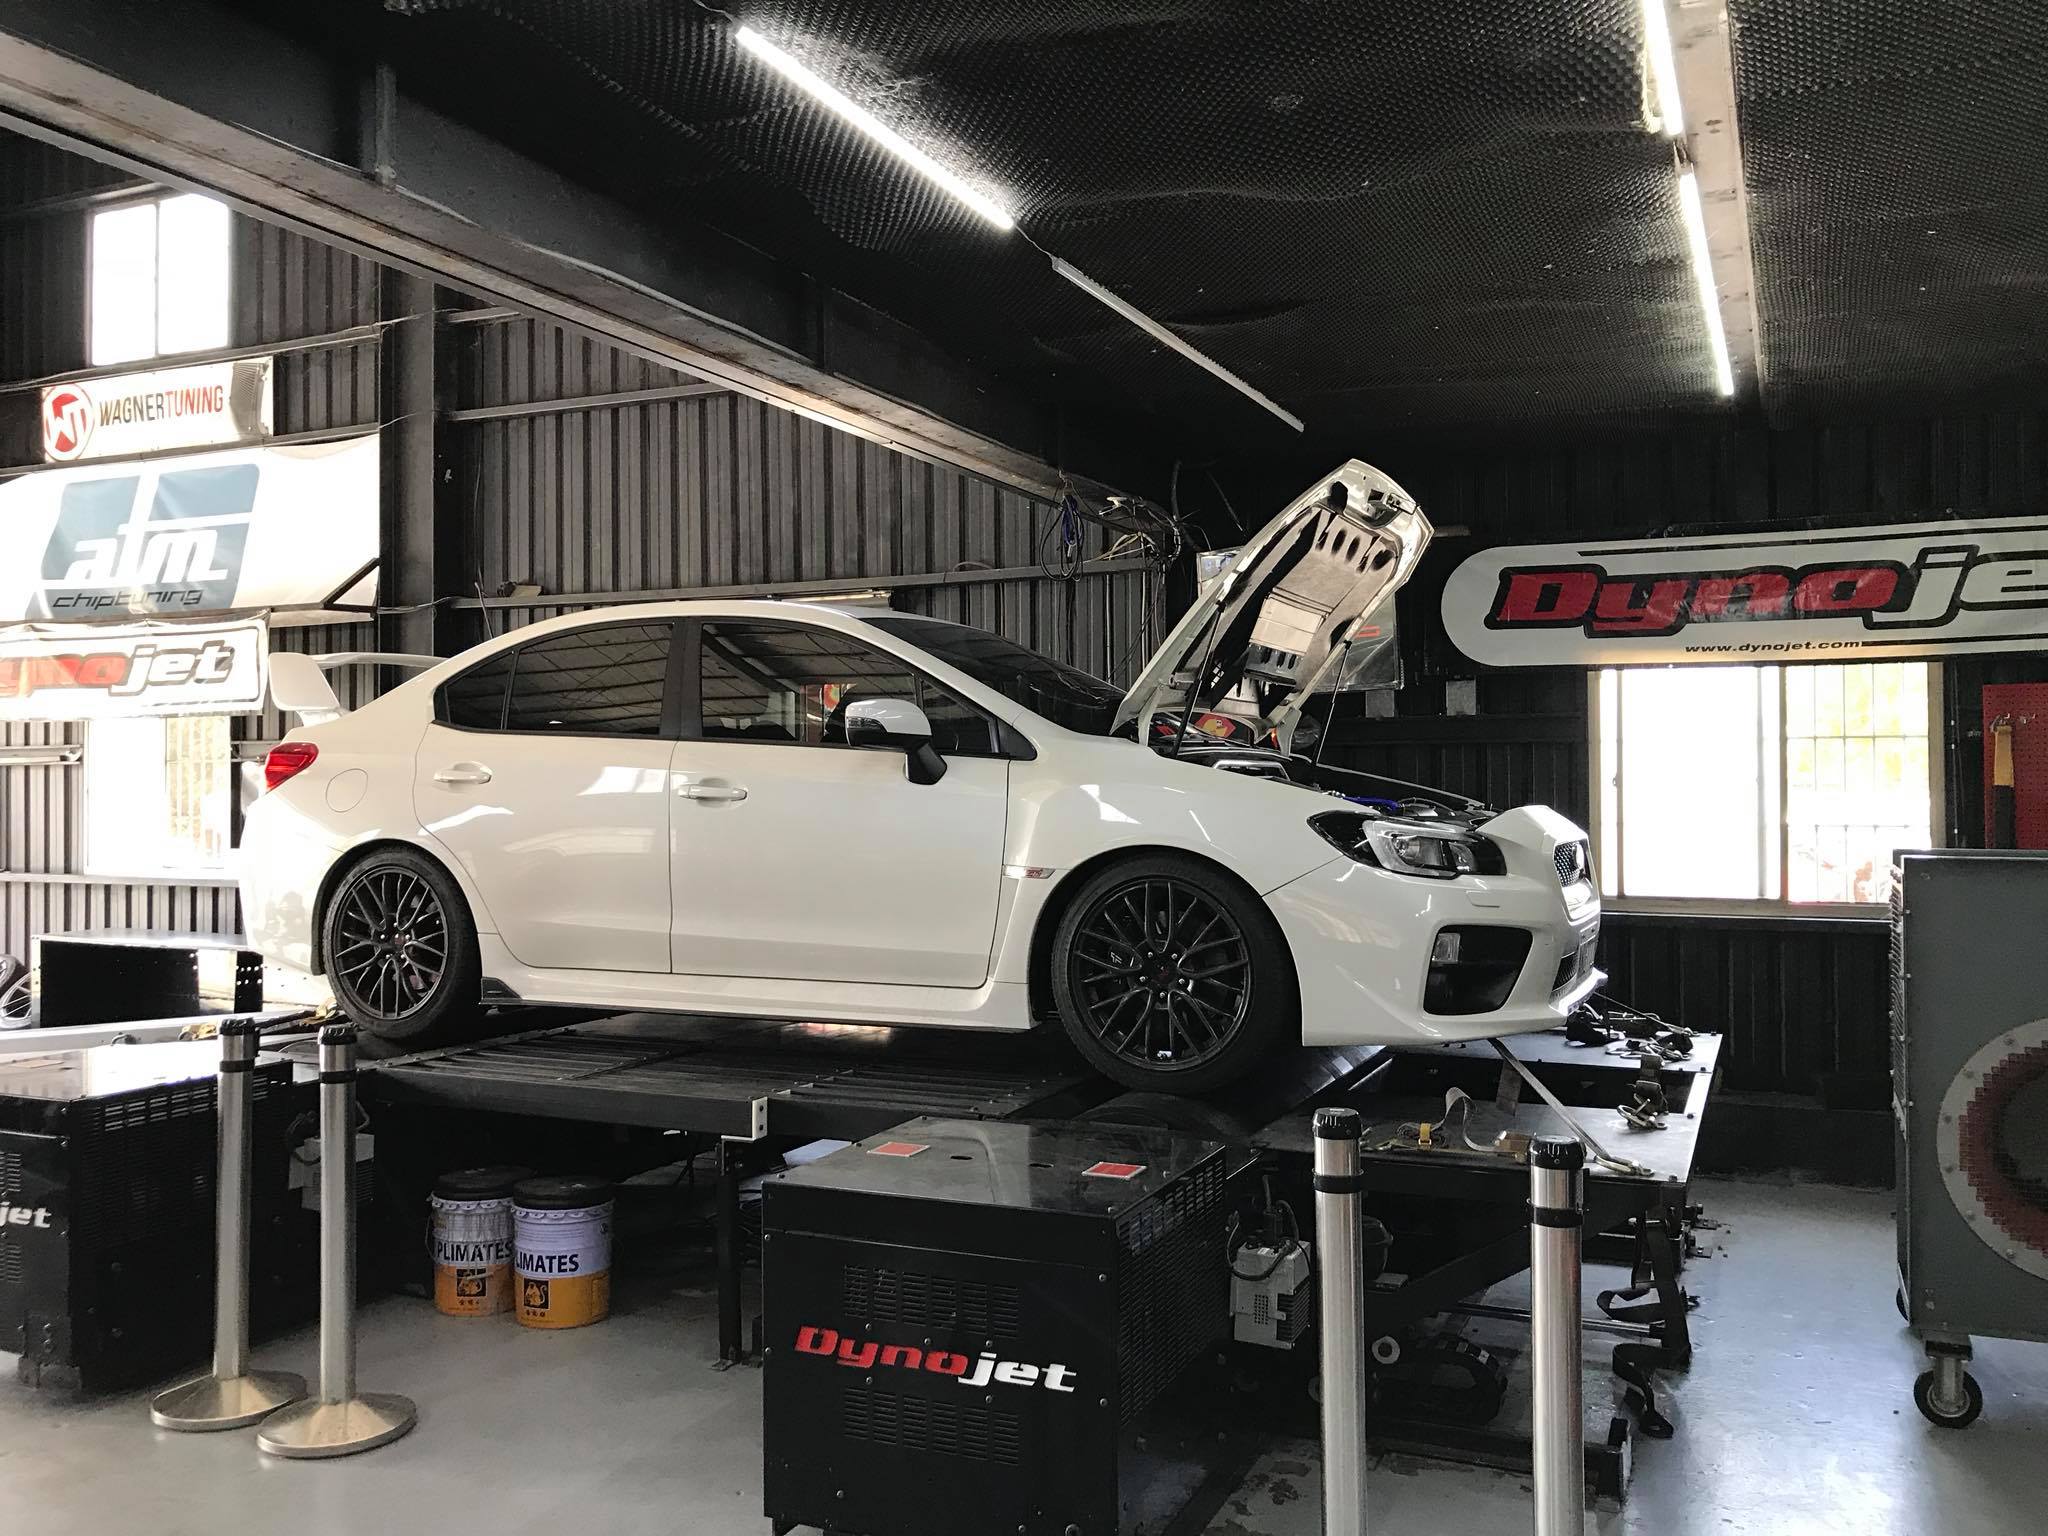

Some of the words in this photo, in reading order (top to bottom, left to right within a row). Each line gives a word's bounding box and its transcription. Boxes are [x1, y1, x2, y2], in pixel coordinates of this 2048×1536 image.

[99, 384, 224, 427] WAGNERTUNING
[52, 588, 204, 609] chiptuning
[1684, 641, 1861, 654] www.dynojet.com
[794, 1323, 1078, 1393] Dynojet
